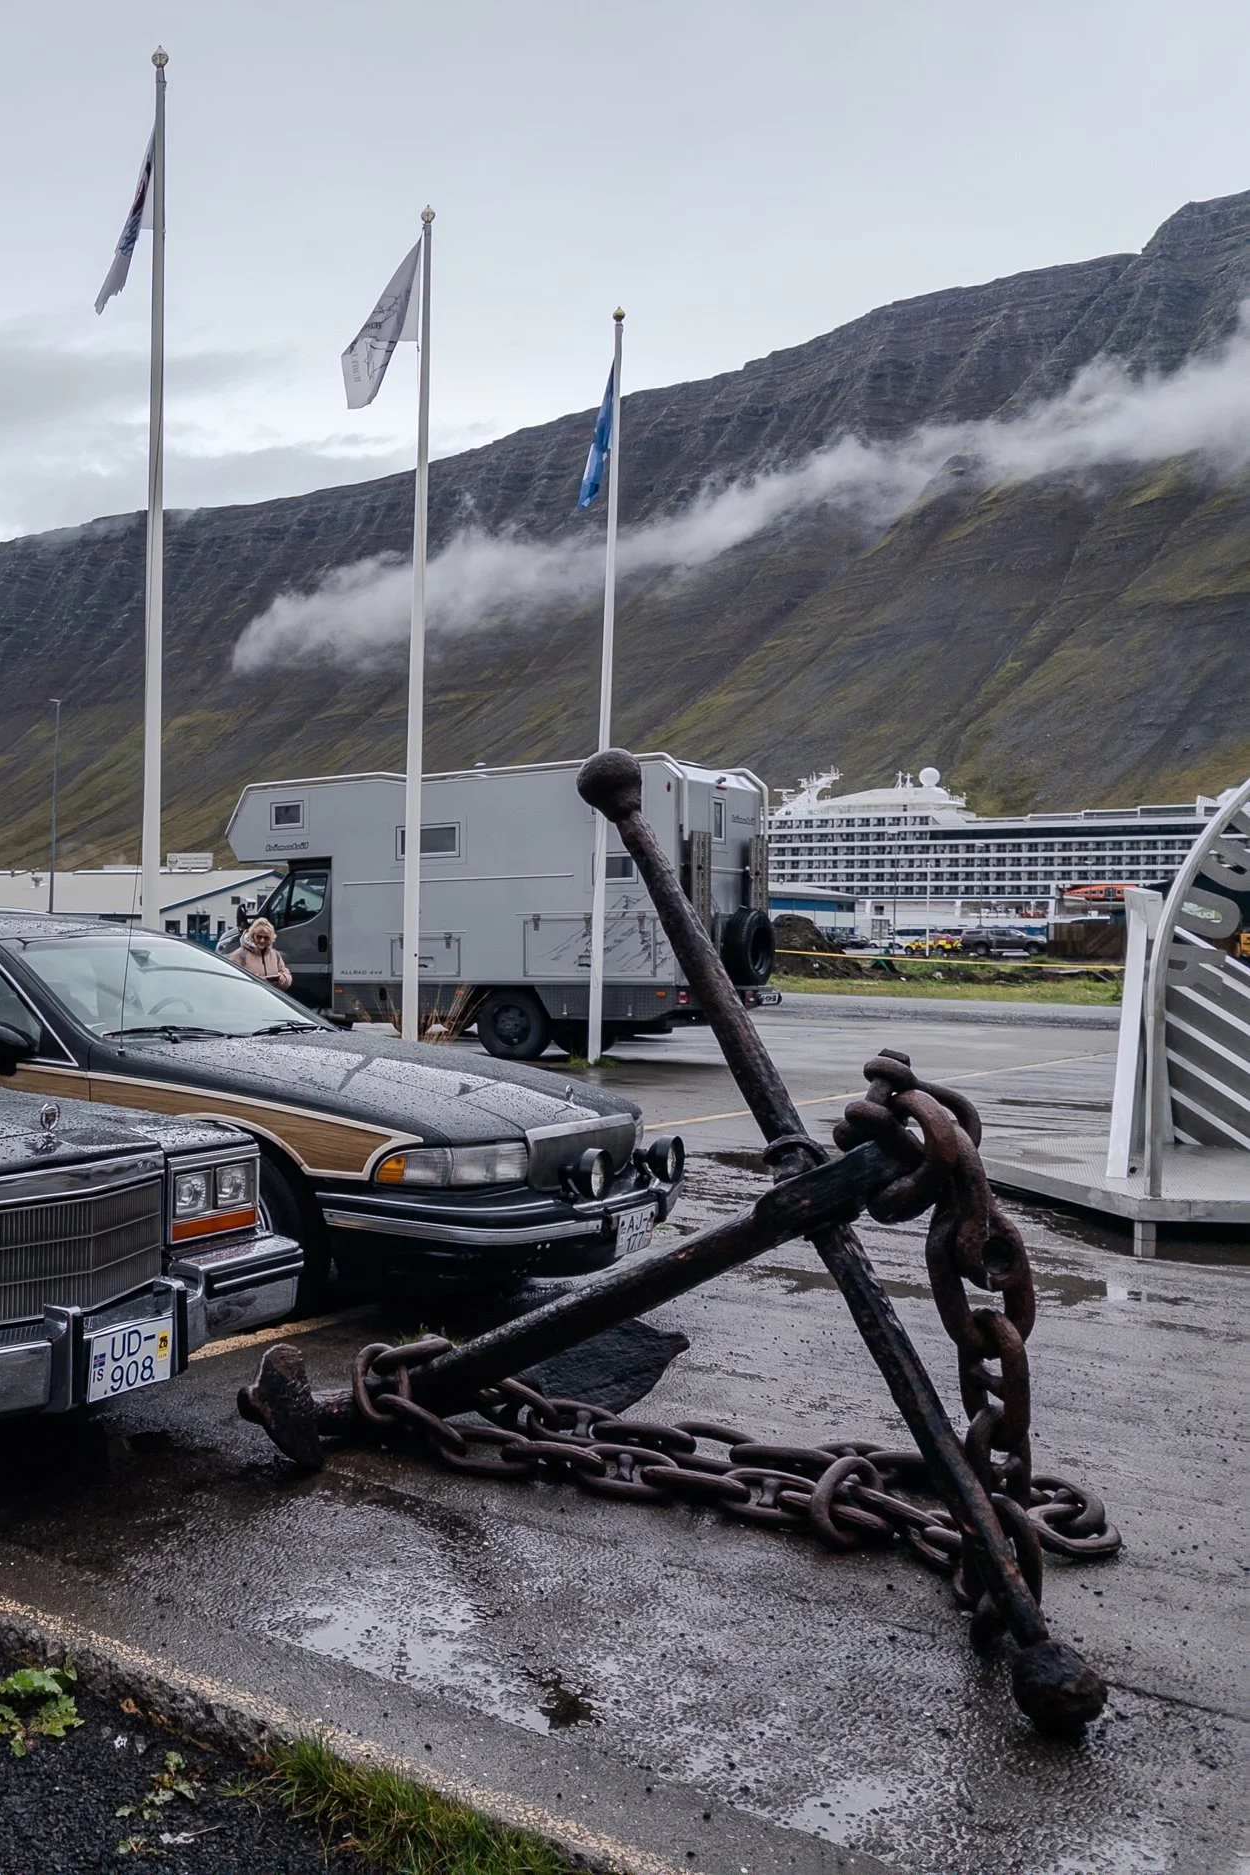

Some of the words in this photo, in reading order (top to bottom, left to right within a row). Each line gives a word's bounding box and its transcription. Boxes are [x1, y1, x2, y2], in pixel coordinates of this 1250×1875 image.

[627, 1230, 645, 1252] 177
[92, 1368, 104, 1383] IS
[111, 1355, 154, 1392] 908
